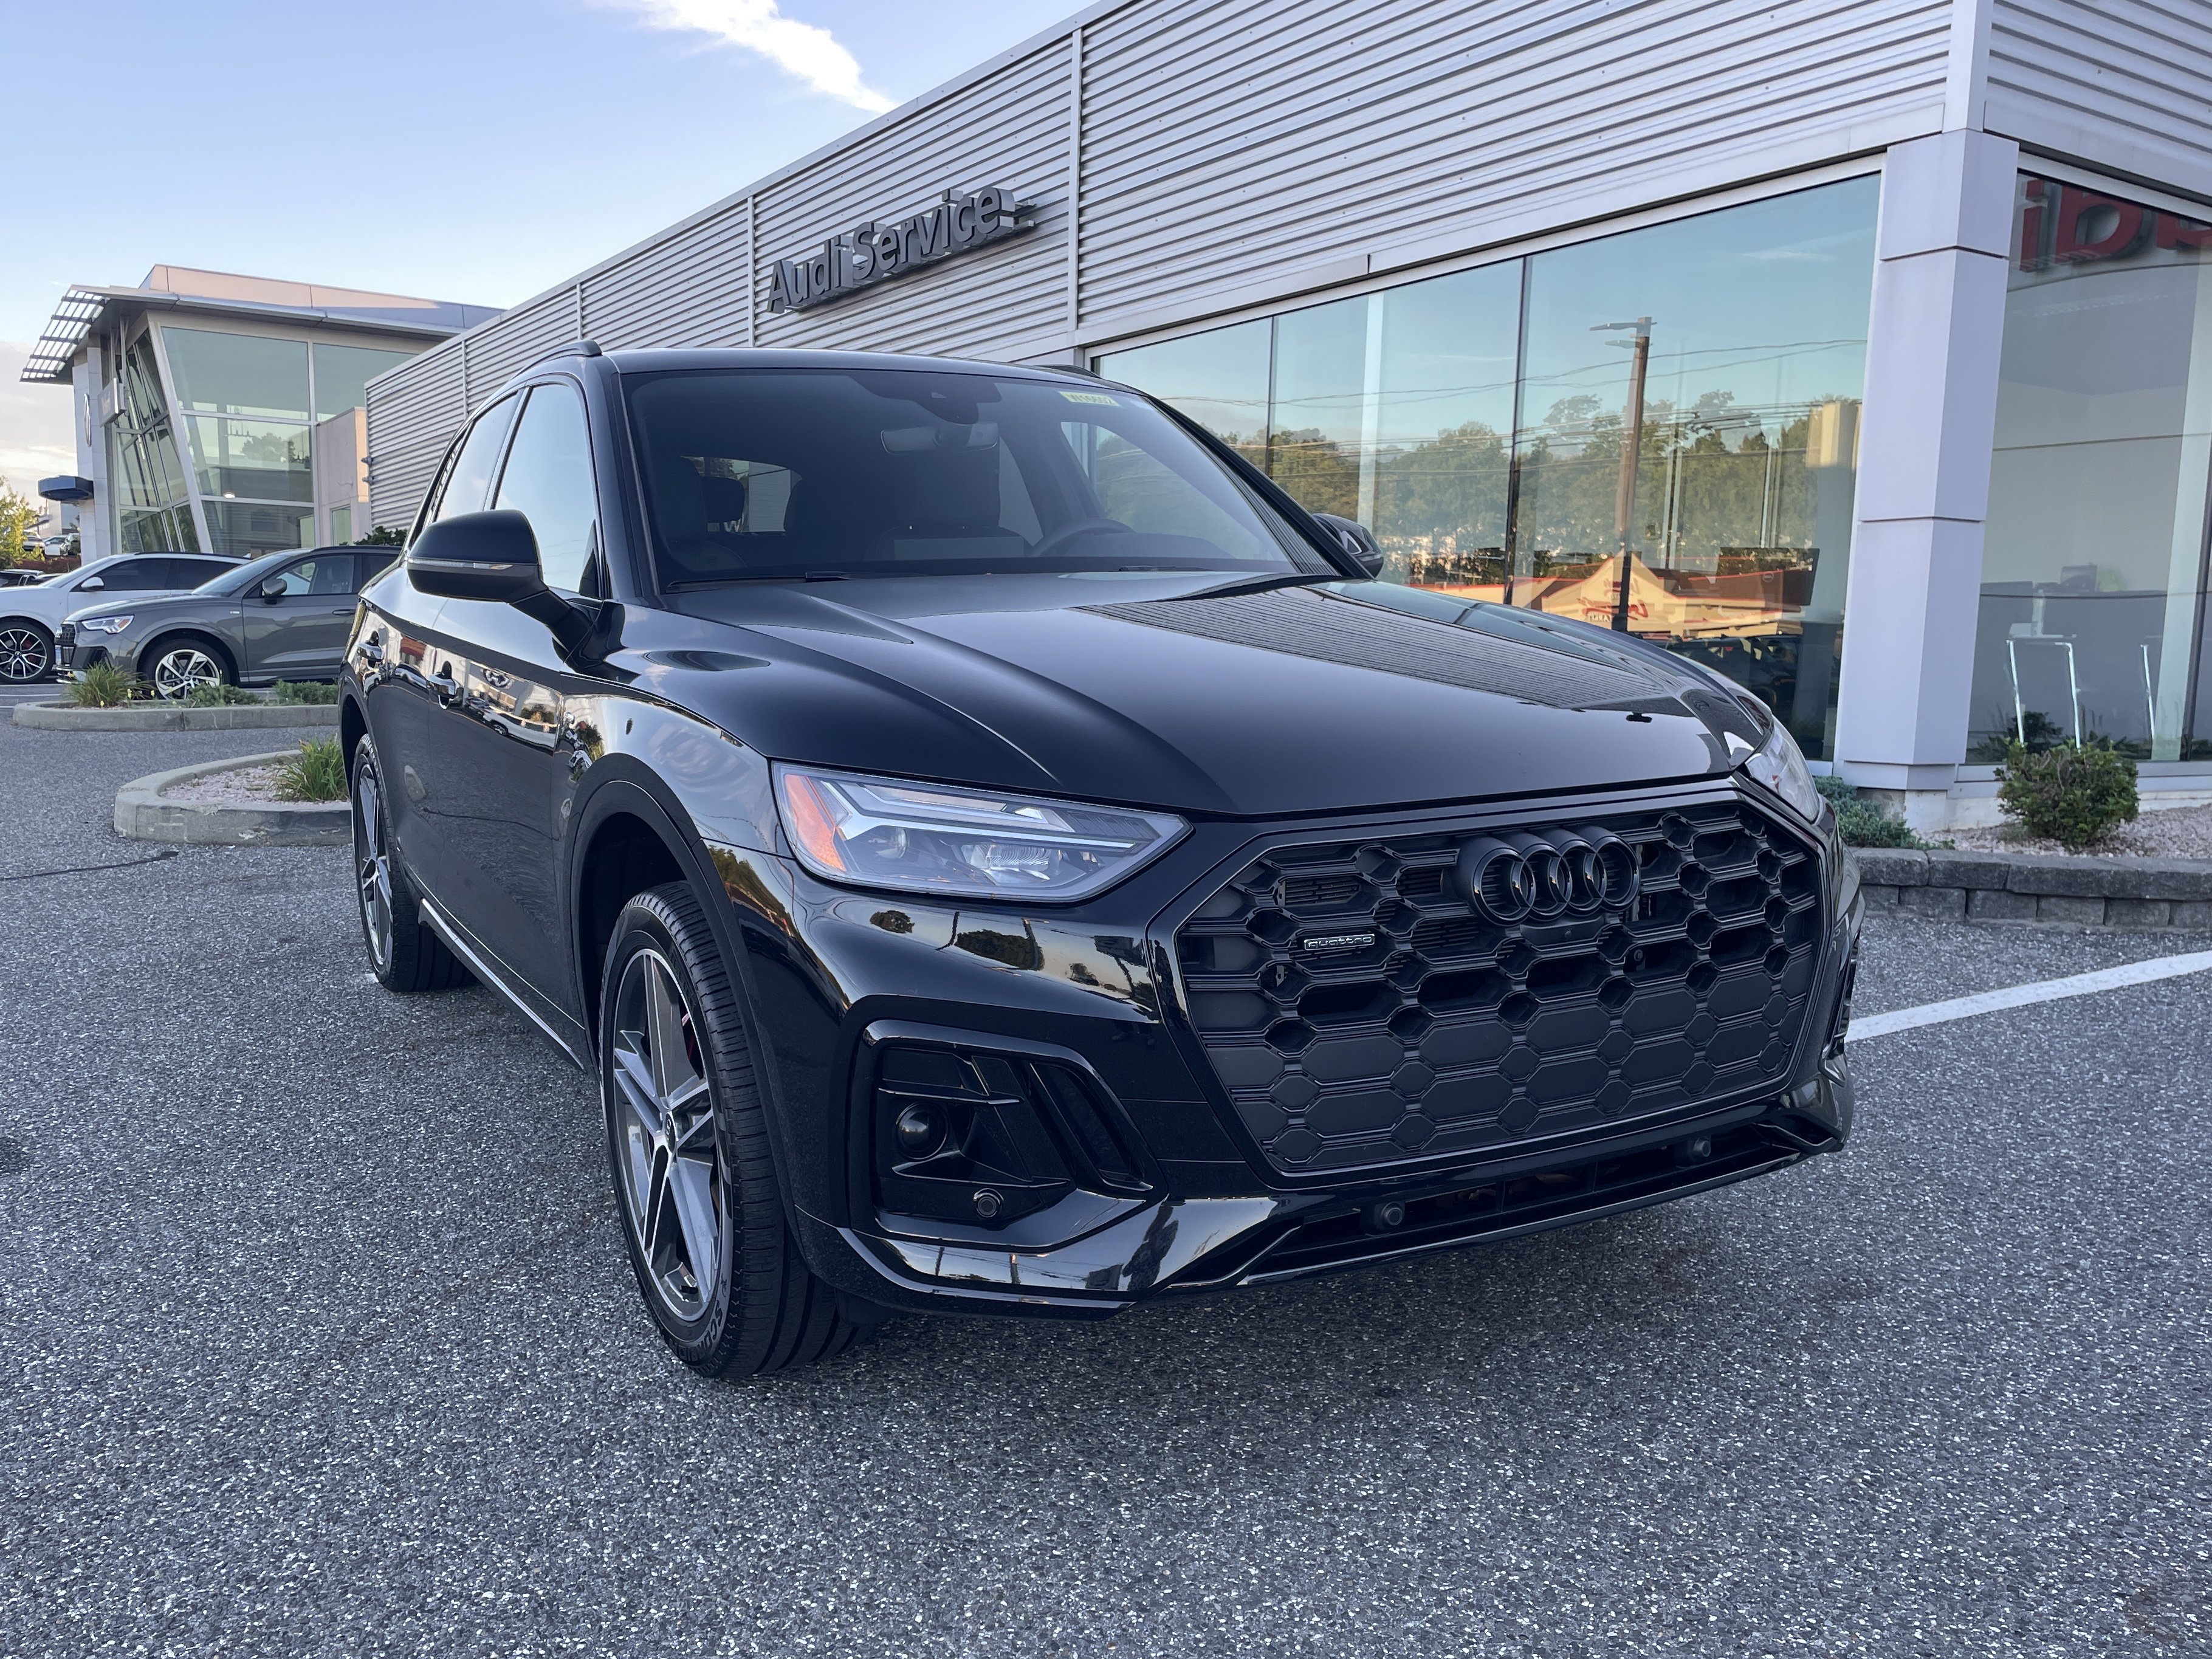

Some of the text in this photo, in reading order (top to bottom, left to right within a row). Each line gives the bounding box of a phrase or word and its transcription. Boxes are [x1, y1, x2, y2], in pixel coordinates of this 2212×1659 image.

[766, 186, 1014, 313] Audi Service
[1308, 936, 1372, 949] quattro
